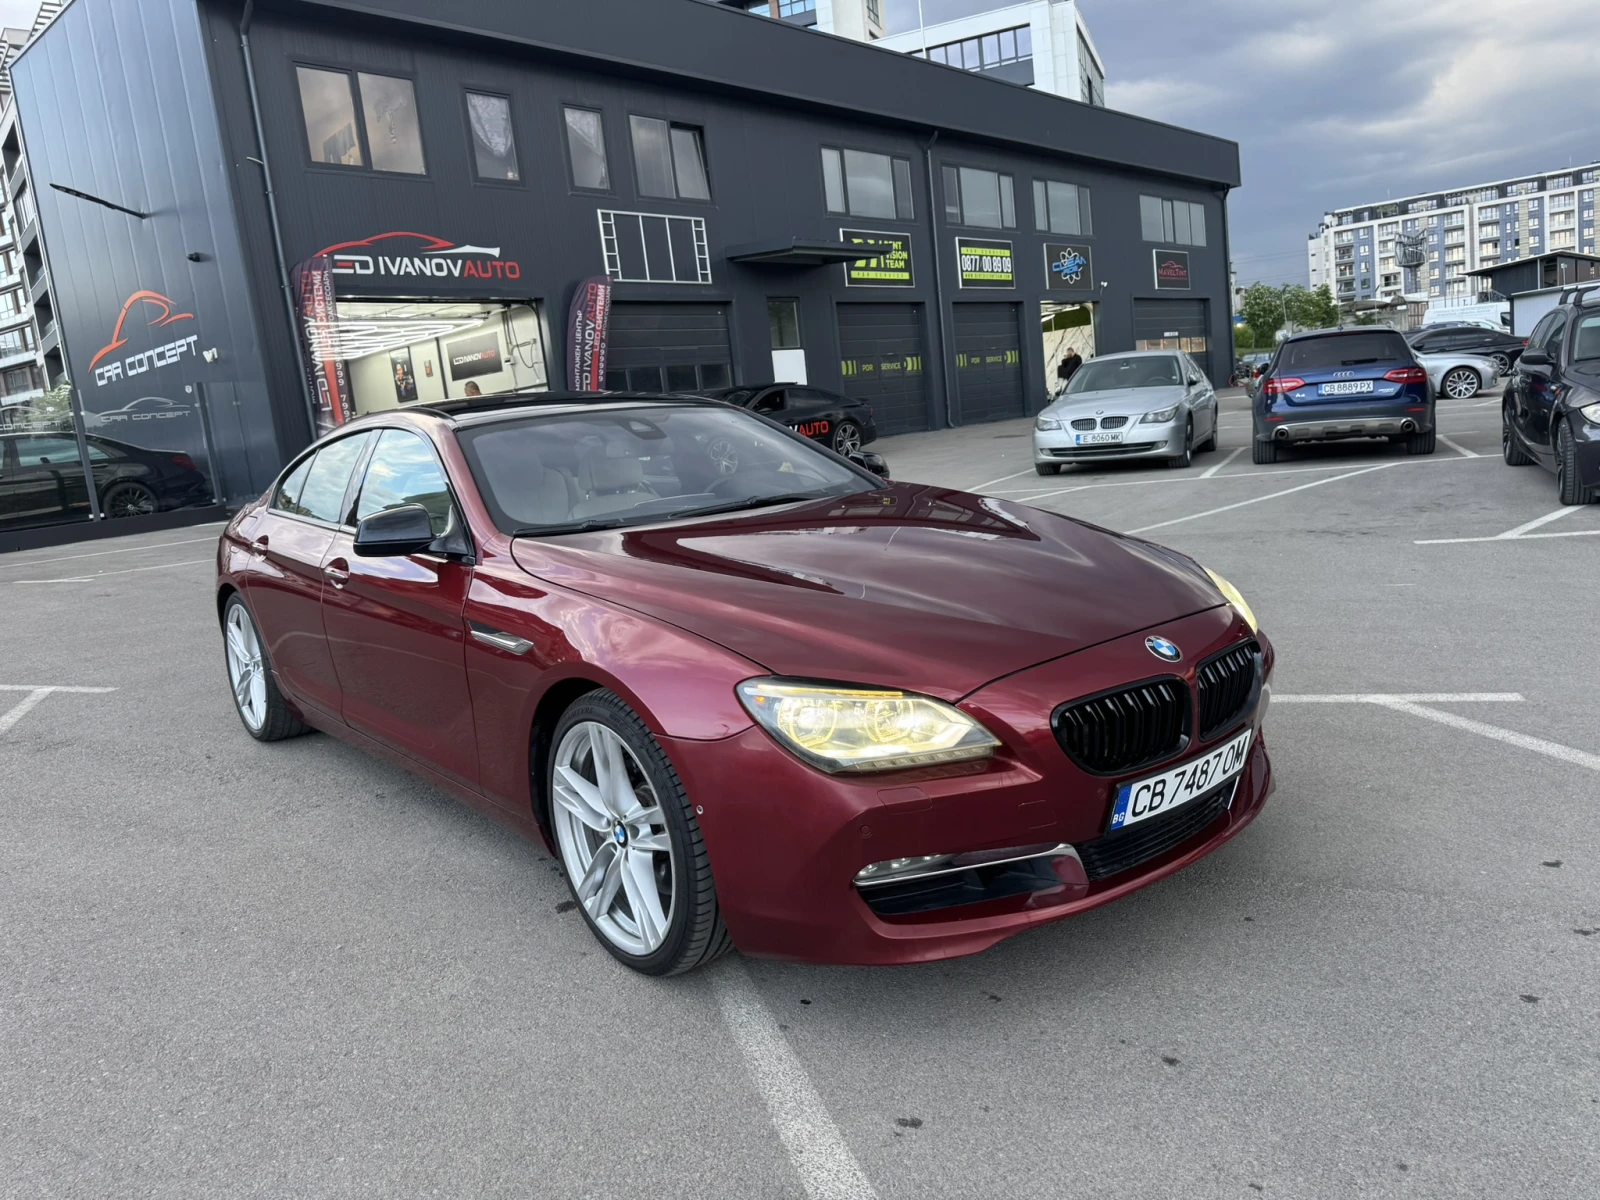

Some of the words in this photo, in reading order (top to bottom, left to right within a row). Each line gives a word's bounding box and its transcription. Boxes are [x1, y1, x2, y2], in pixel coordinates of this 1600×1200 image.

[886, 260, 905, 268] TEAM
[961, 255, 980, 271] 0877
[982, 256, 992, 272] 00
[993, 256, 1002, 272] 89
[1002, 257, 1012, 273] 09
[595, 284, 606, 330] СИСТЕМИ
[95, 361, 124, 387] CAR
[125, 334, 198, 377] CONCEPT
[986, 355, 1002, 363] SERVICE
[880, 362, 901, 371] SERVICE
[1323, 384, 1335, 393] CB
[1337, 382, 1359, 392] 8889
[1360, 381, 1372, 390] PX
[101, 414, 128, 423] CAR
[132, 410, 191, 420] CONCEPT
[1131, 779, 1167, 818] CB
[1168, 751, 1223, 805] 7487
[1222, 736, 1248, 775] OM
[1112, 812, 1125, 824] BG
